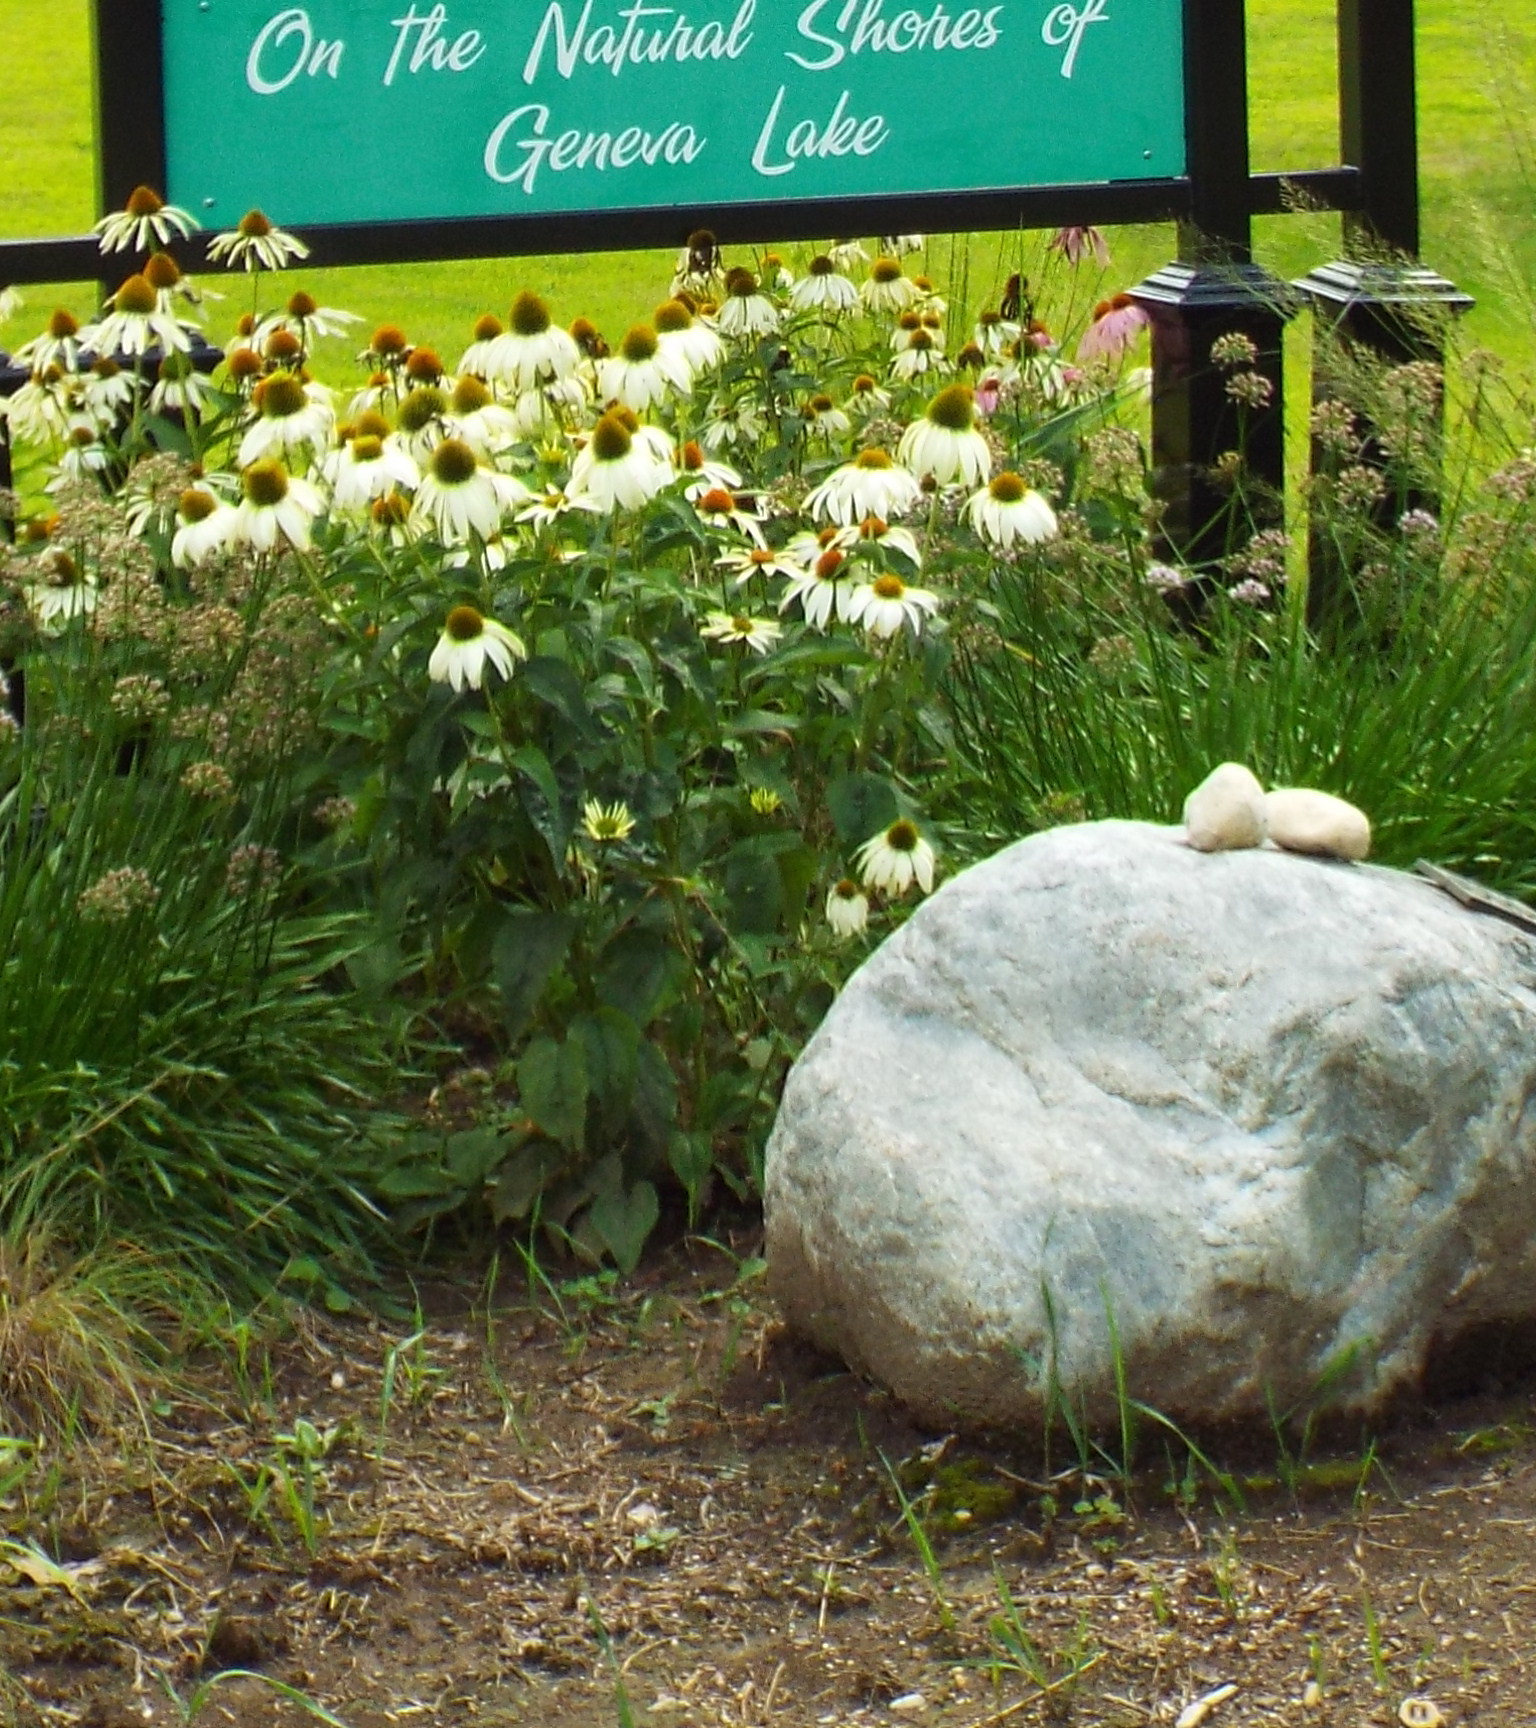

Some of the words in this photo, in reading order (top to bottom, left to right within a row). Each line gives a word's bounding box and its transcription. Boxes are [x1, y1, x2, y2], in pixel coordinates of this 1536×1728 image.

[246, 8, 344, 95] On
[383, 3, 487, 86] the
[483, 104, 707, 195] Geneva
[751, 85, 890, 176] Lake
